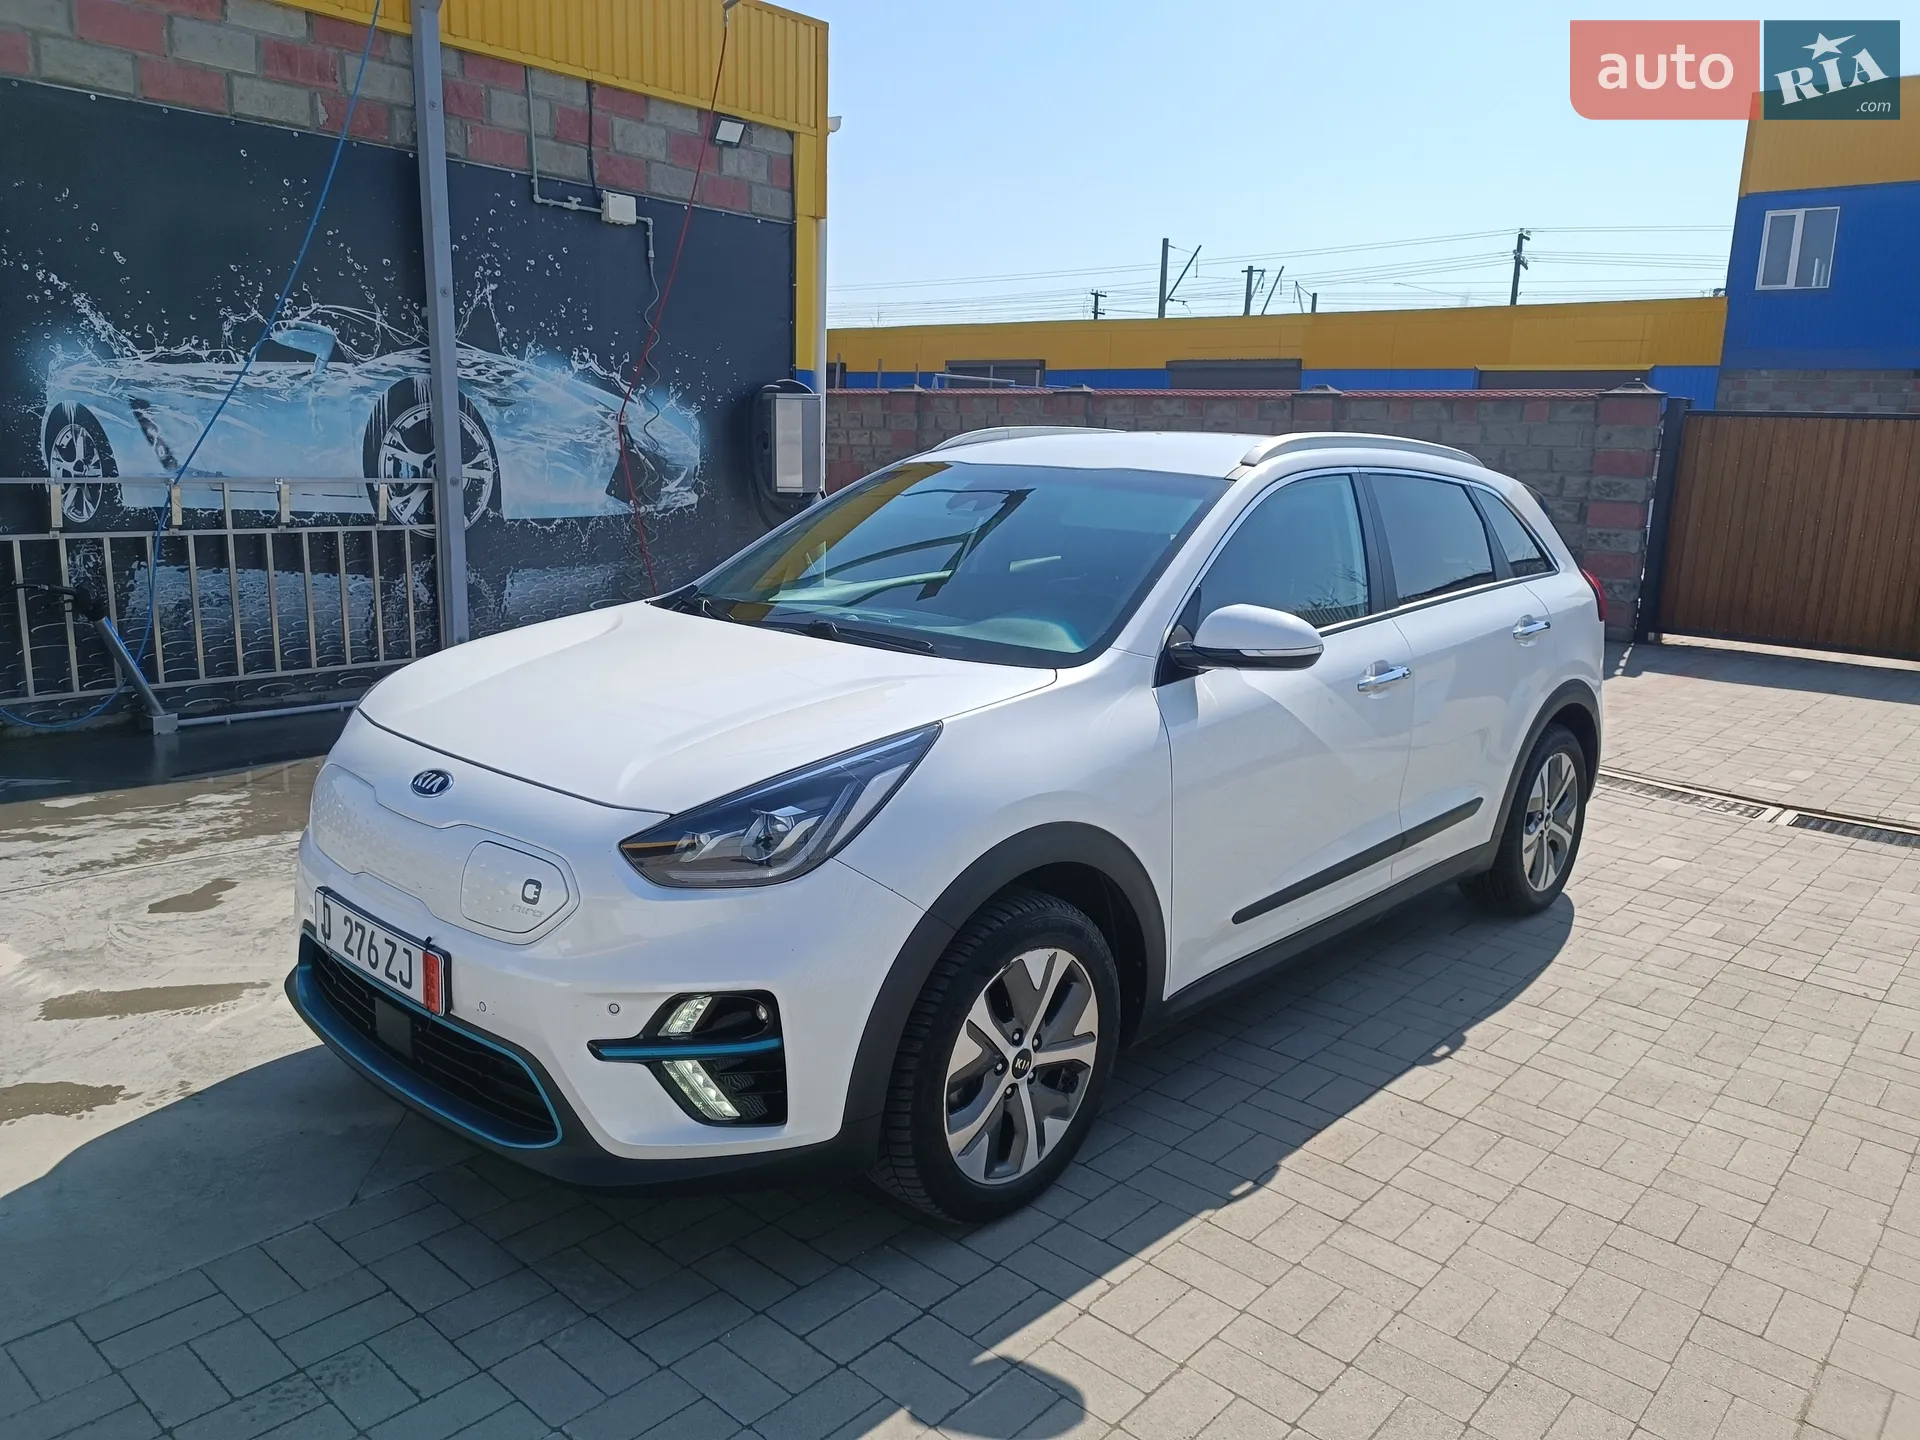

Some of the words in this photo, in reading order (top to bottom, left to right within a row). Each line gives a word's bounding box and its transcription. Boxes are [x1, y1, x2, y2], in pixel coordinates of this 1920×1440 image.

[413, 771, 445, 793] KIA
[343, 915, 379, 970] 276
[1015, 1058, 1030, 1071] KIA
